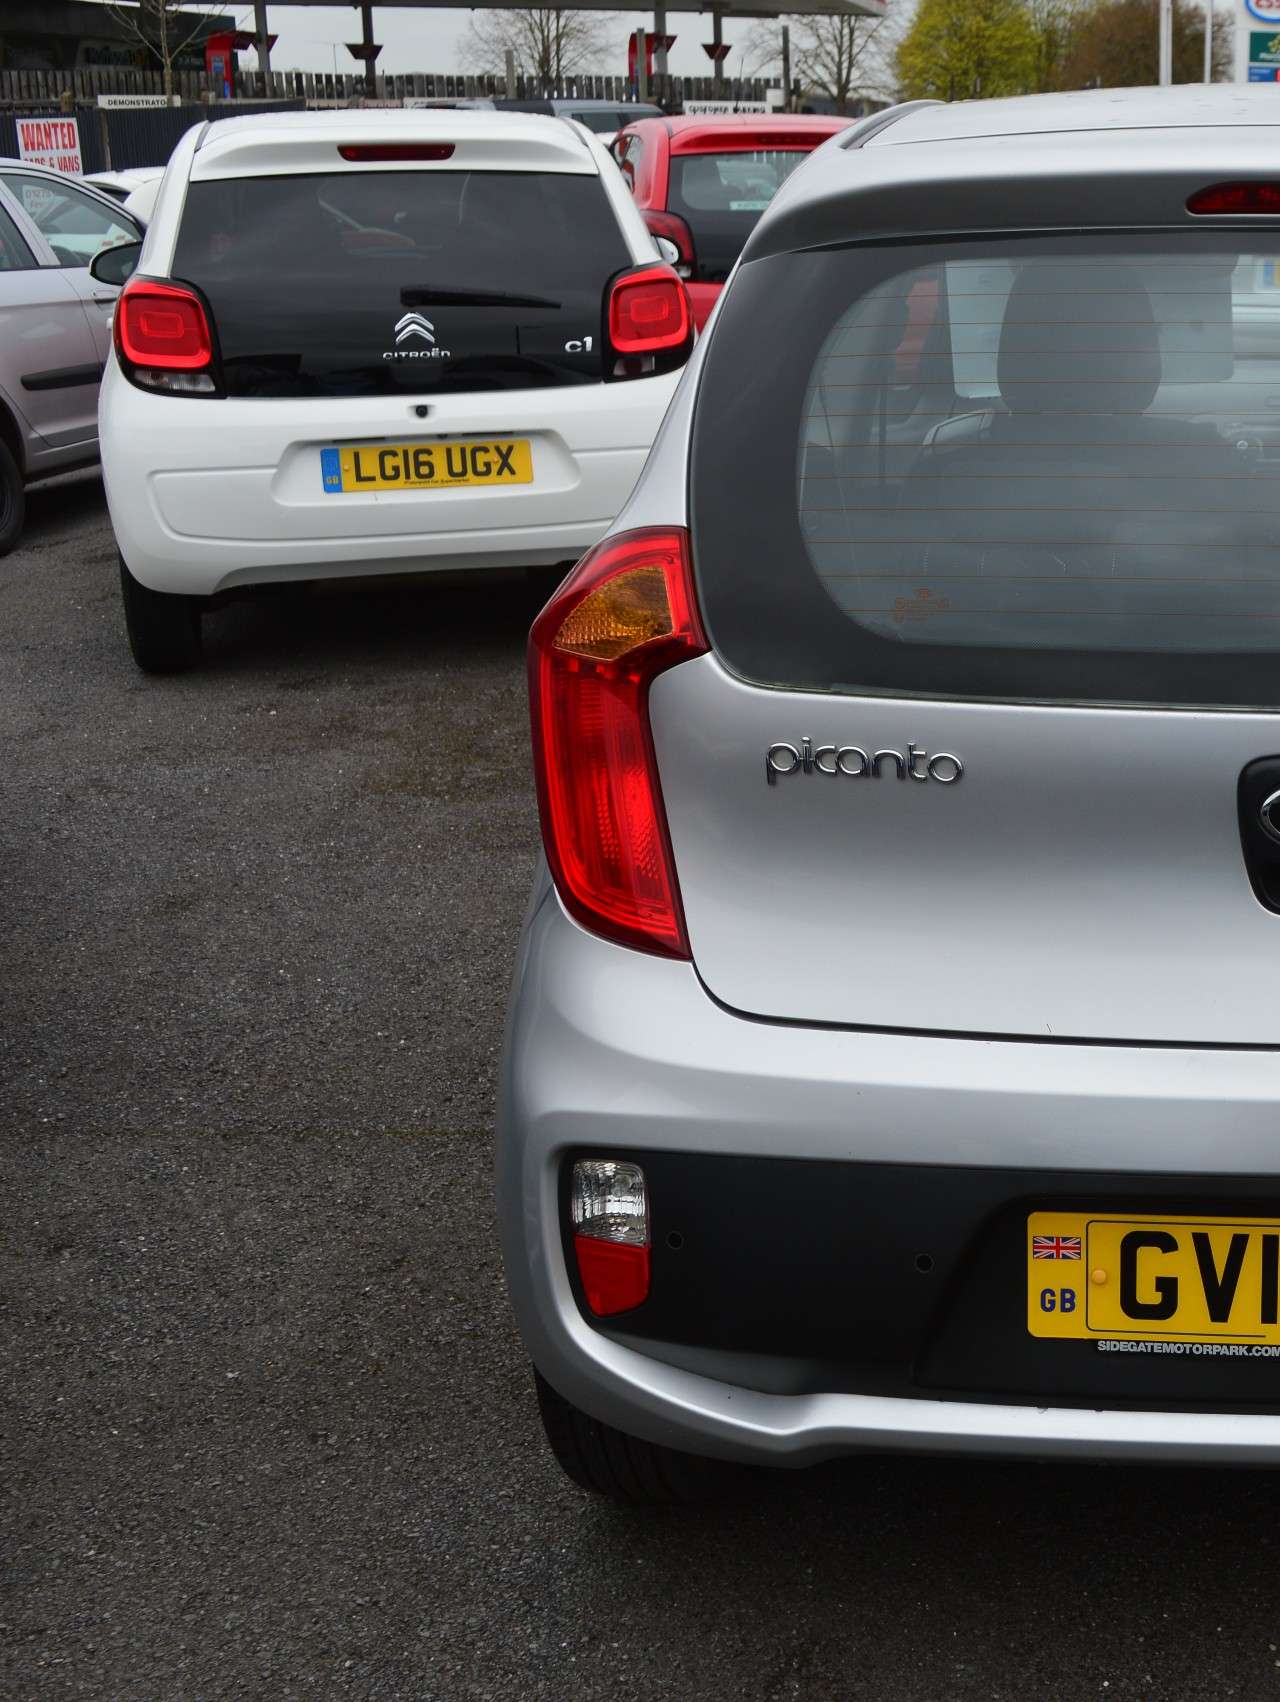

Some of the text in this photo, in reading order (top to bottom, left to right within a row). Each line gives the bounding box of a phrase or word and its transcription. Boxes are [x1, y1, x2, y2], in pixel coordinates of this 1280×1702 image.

[107, 99, 168, 107] DEMONSTRATO
[20, 121, 77, 151] WANTED
[57, 154, 81, 172] VANS
[353, 444, 516, 483] LG16 UGX
[766, 736, 964, 785] picanto
[1039, 1287, 1077, 1314] GB
